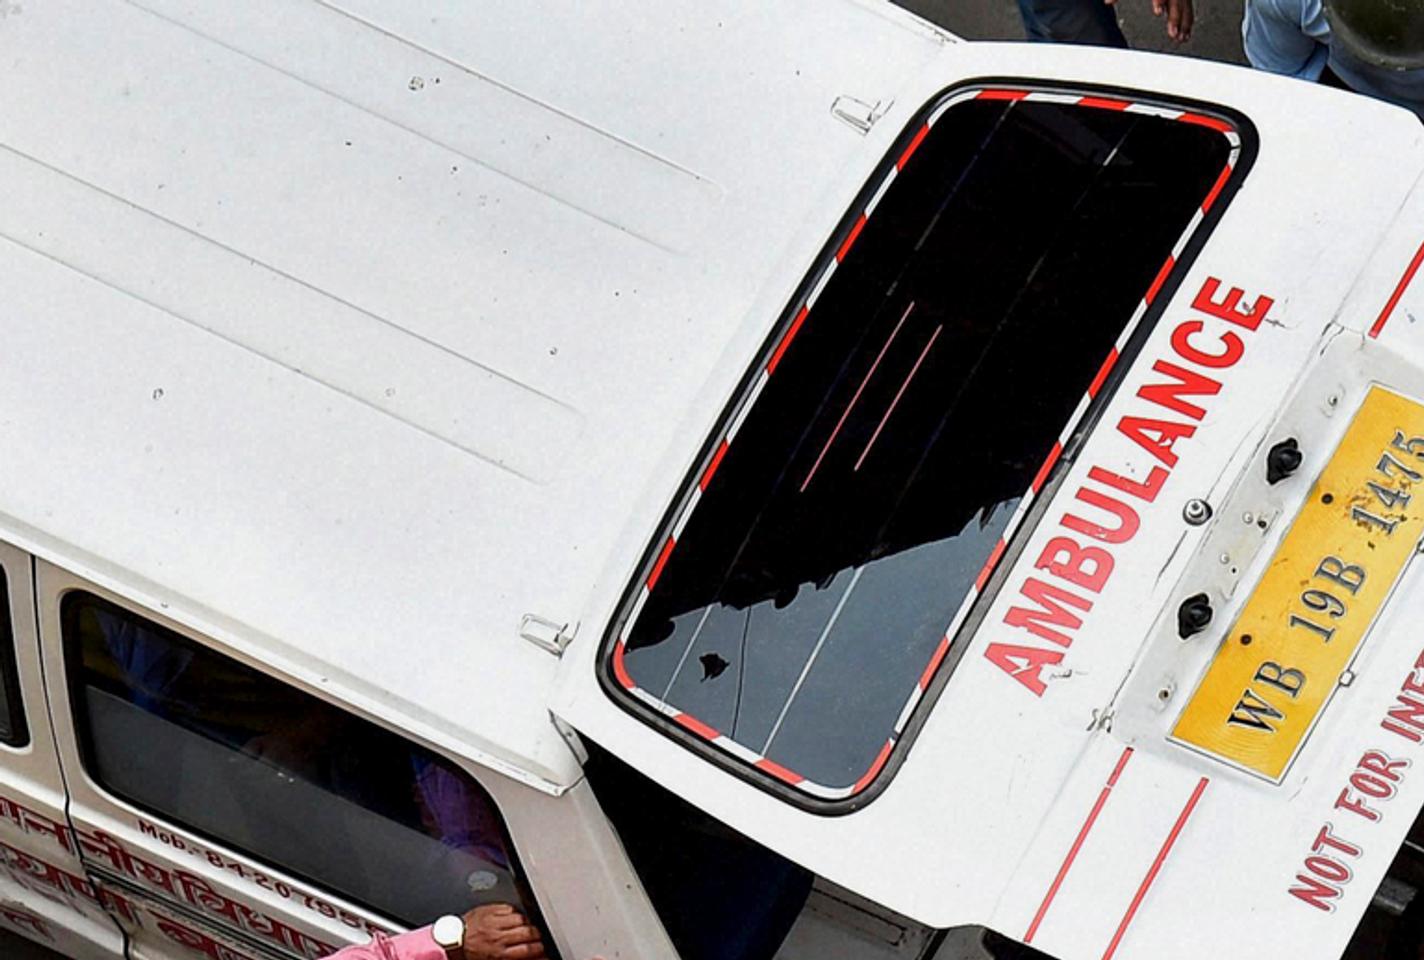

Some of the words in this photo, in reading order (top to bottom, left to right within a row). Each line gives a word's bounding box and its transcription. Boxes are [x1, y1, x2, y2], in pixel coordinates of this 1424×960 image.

[983, 277, 1275, 698] AMBULANCE
[1227, 660, 1307, 735] WB
[1289, 555, 1367, 643] 19B
[1287, 827, 1358, 912] NOT
[1334, 751, 1408, 823] FOR
